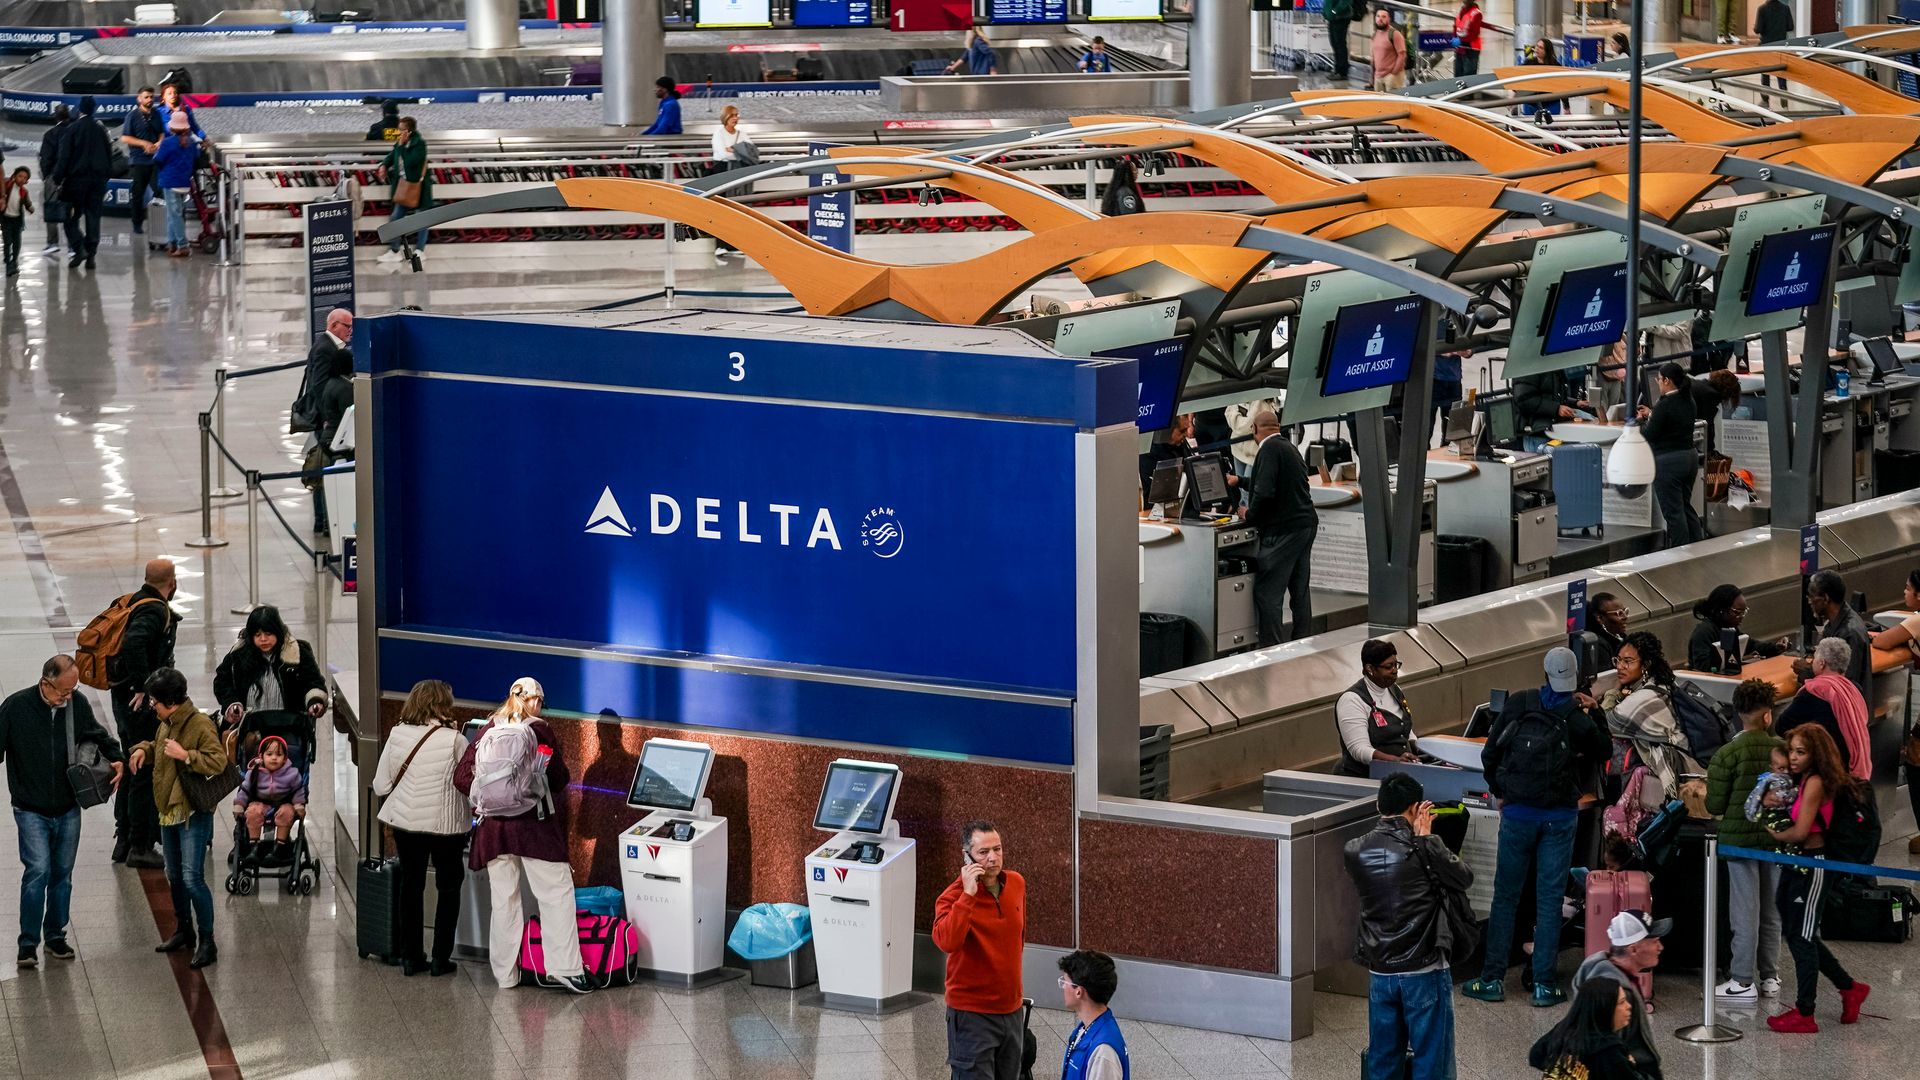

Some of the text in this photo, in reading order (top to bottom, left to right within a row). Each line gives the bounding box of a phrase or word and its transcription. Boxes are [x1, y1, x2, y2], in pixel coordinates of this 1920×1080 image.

[1813, 199, 1823, 210] 64
[320, 209, 342, 218] DELTA
[1739, 210, 1748, 222] 63
[313, 233, 344, 244] ADVICE TO
[313, 242, 349, 253] PASSENGERS
[1539, 244, 1548, 256] 61
[1310, 280, 1321, 292] 59
[1767, 282, 1809, 298] AGENT ASSIST
[1164, 306, 1176, 319] 58
[1400, 302, 1416, 311] DELTA
[1062, 323, 1075, 336] 57
[1565, 319, 1611, 337] AGENT ASSIST
[1160, 345, 1178, 355] DELTA
[728, 352, 746, 382] 3
[1345, 358, 1395, 377] AGENT ASSIST
[1138, 404, 1155, 417] SIST
[650, 493, 843, 551] DELTA
[860, 506, 894, 547] SKYTEAM
[643, 894, 670, 904] DELTA
[831, 917, 858, 928] DELTA
